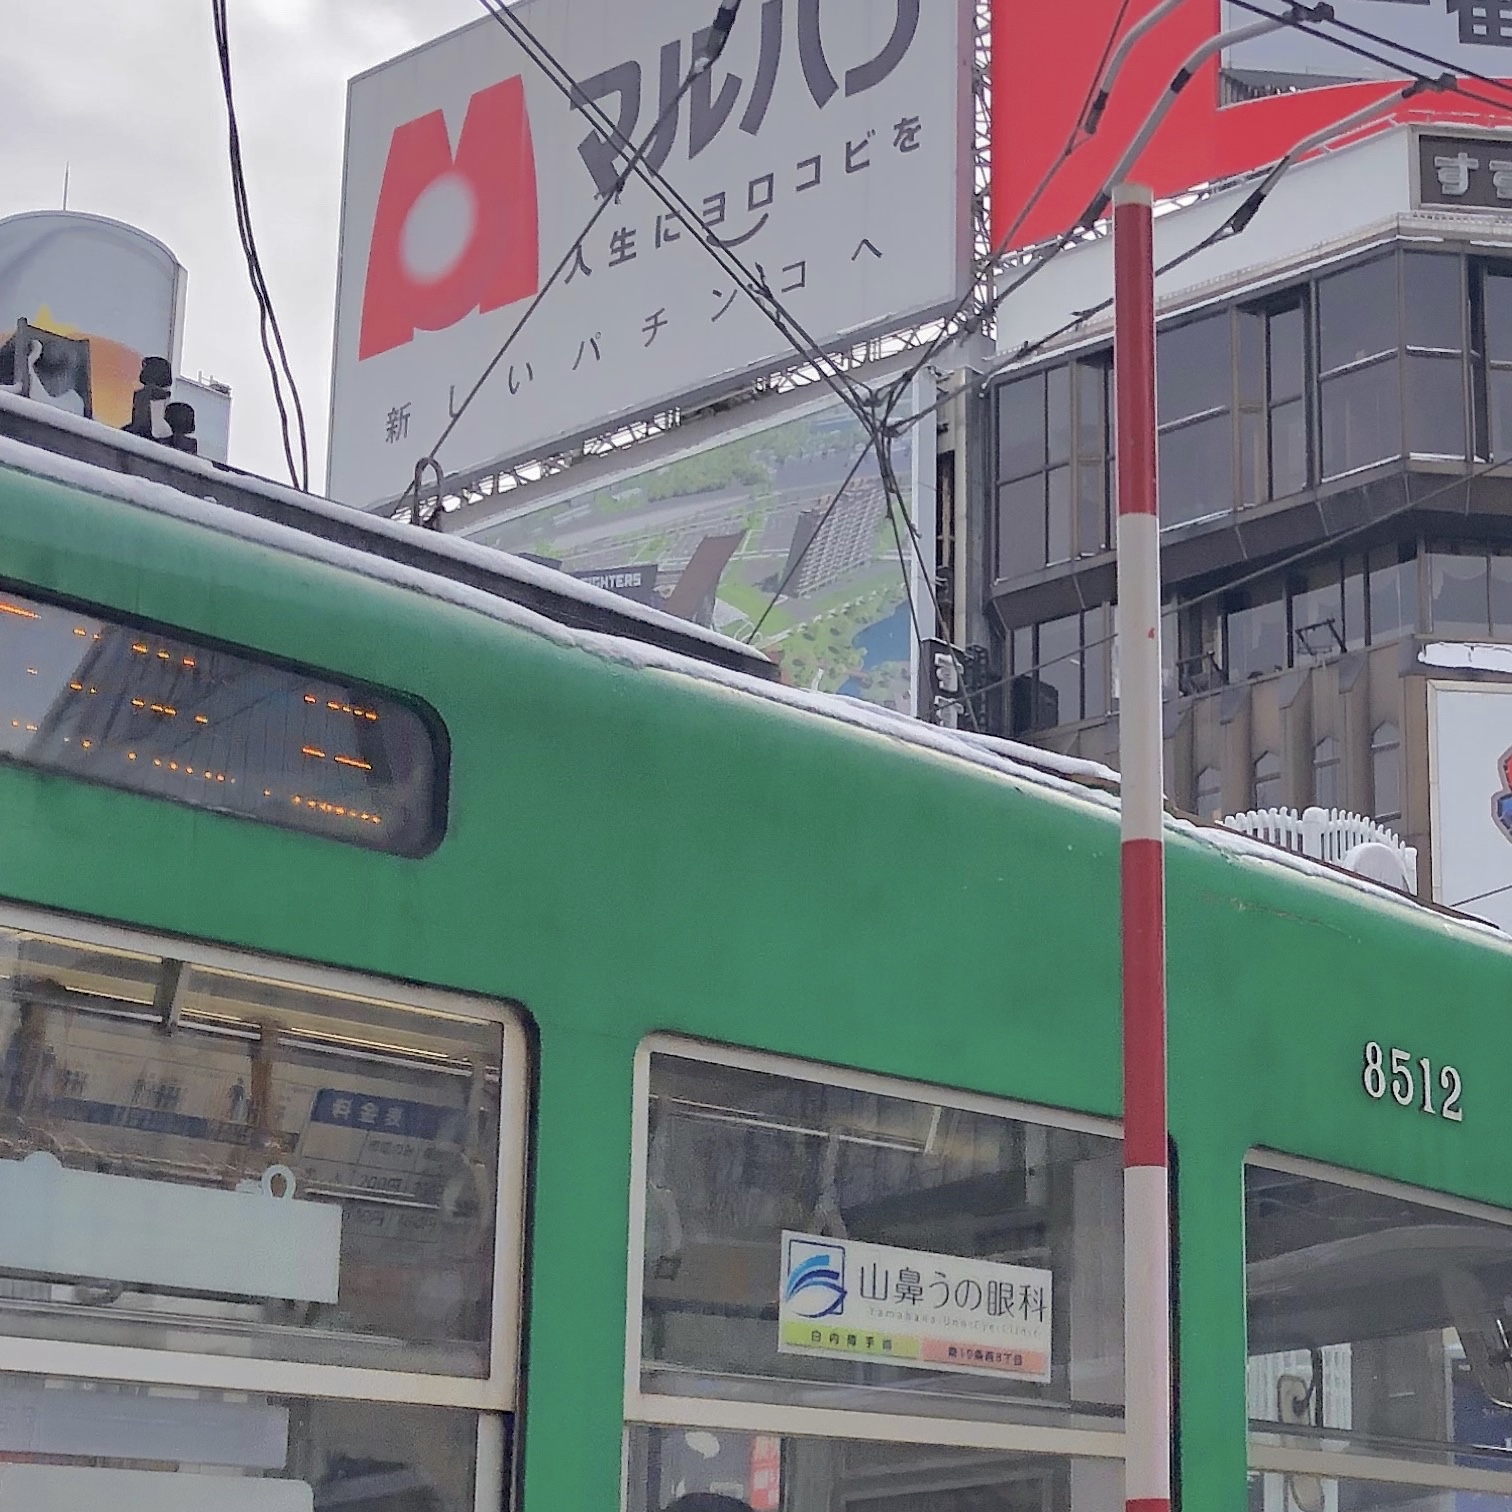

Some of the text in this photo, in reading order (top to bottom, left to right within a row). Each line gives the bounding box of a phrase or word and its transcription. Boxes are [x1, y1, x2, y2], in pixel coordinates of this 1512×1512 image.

[565, 116, 922, 283] 人生にヨロコビを
[385, 238, 882, 444] 新しいパチンコへ
[1363, 1041, 1463, 1122] 8512
[860, 1262, 1048, 1323] 山鼻うの眼科
